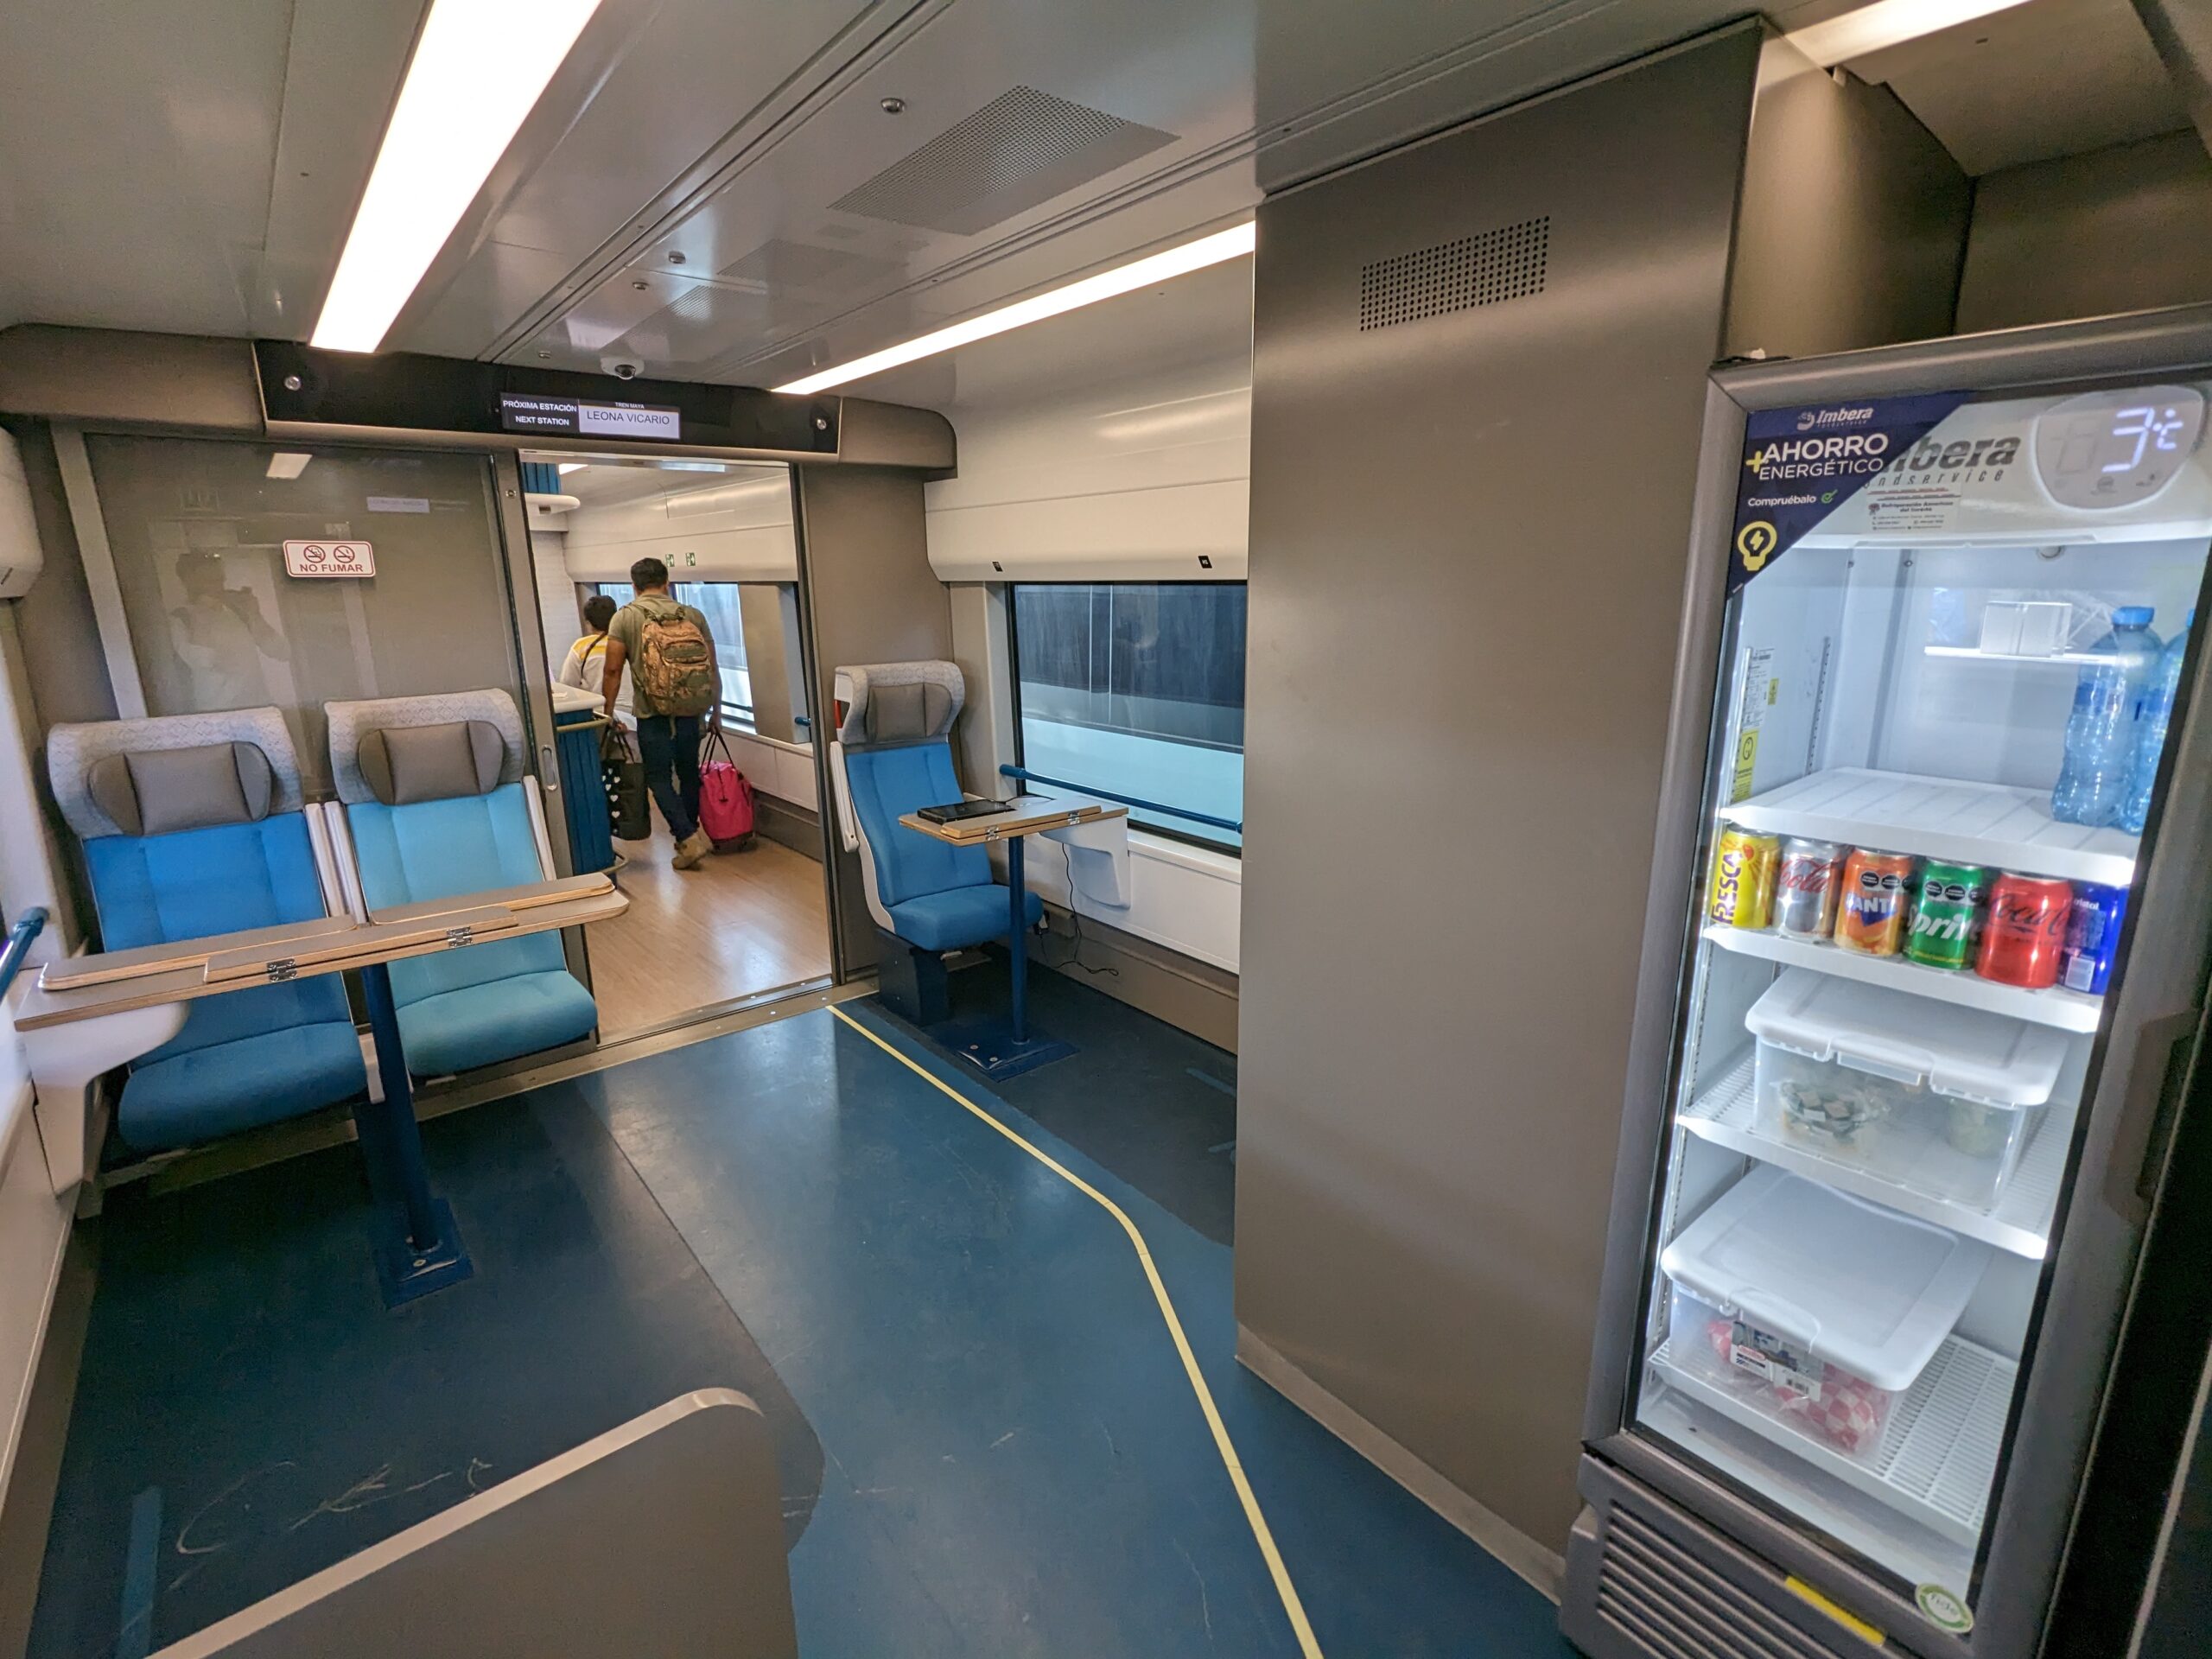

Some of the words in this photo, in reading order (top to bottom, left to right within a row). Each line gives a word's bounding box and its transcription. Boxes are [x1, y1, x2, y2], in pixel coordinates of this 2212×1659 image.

[503, 400, 538, 410] PRÓXIMA
[539, 403, 577, 412] ESTACIÓN
[537, 416, 569, 425] STATION
[587, 410, 624, 423] LEONA
[626, 413, 670, 425] VICARIO
[1758, 458, 1884, 480] ENERGÉTICO
[1748, 495, 1817, 507] Compruébalo
[300, 563, 318, 572] NO
[321, 563, 364, 572] FUMAR
[1711, 851, 1743, 925] FRESCA
